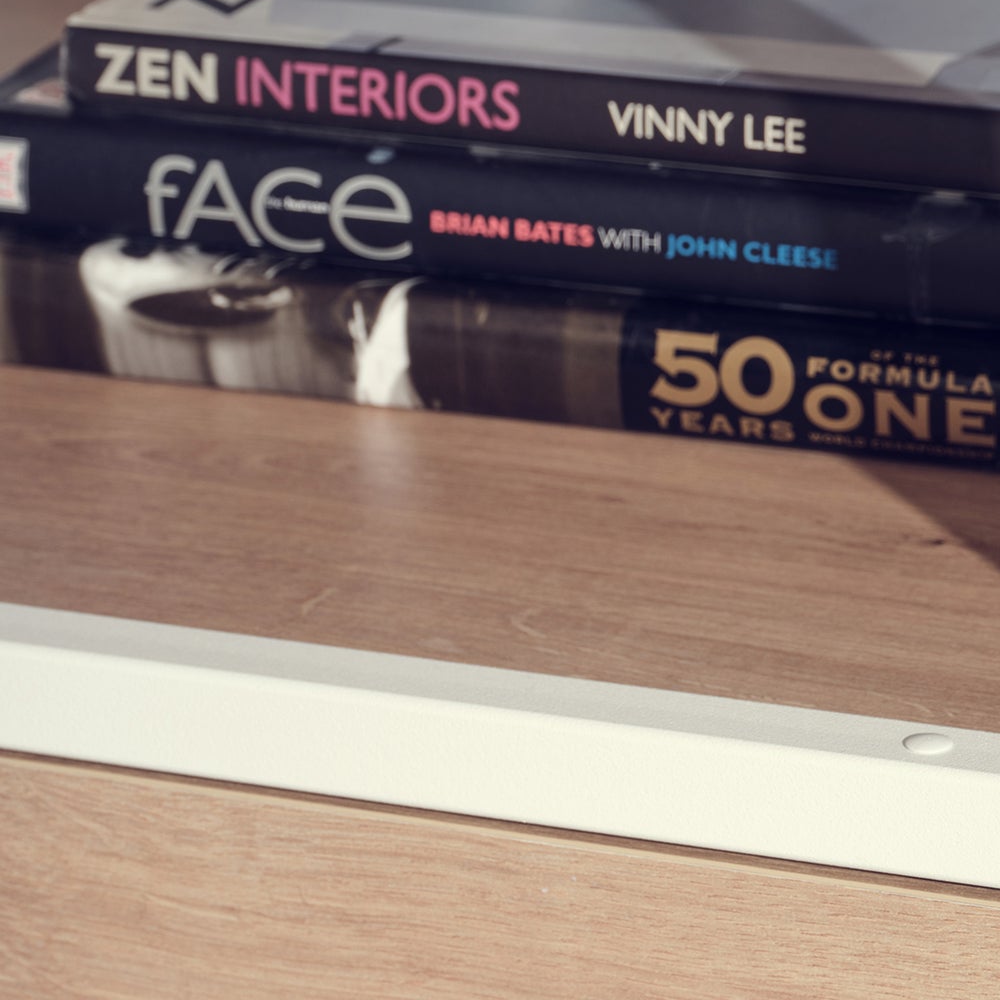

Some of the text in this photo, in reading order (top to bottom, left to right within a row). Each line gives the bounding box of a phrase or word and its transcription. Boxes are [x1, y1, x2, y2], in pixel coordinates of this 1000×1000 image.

[95, 43, 520, 131] ZEN INTERIORS
[607, 101, 807, 154] VINNY LEE
[430, 210, 839, 270] BRIAN BATES WITH JOHN CLEESE
[650, 329, 796, 416] 50
[806, 356, 994, 396] FORMULA
[870, 349, 940, 367] OF THE
[649, 406, 796, 441] YEARS
[803, 383, 997, 447] ONE
